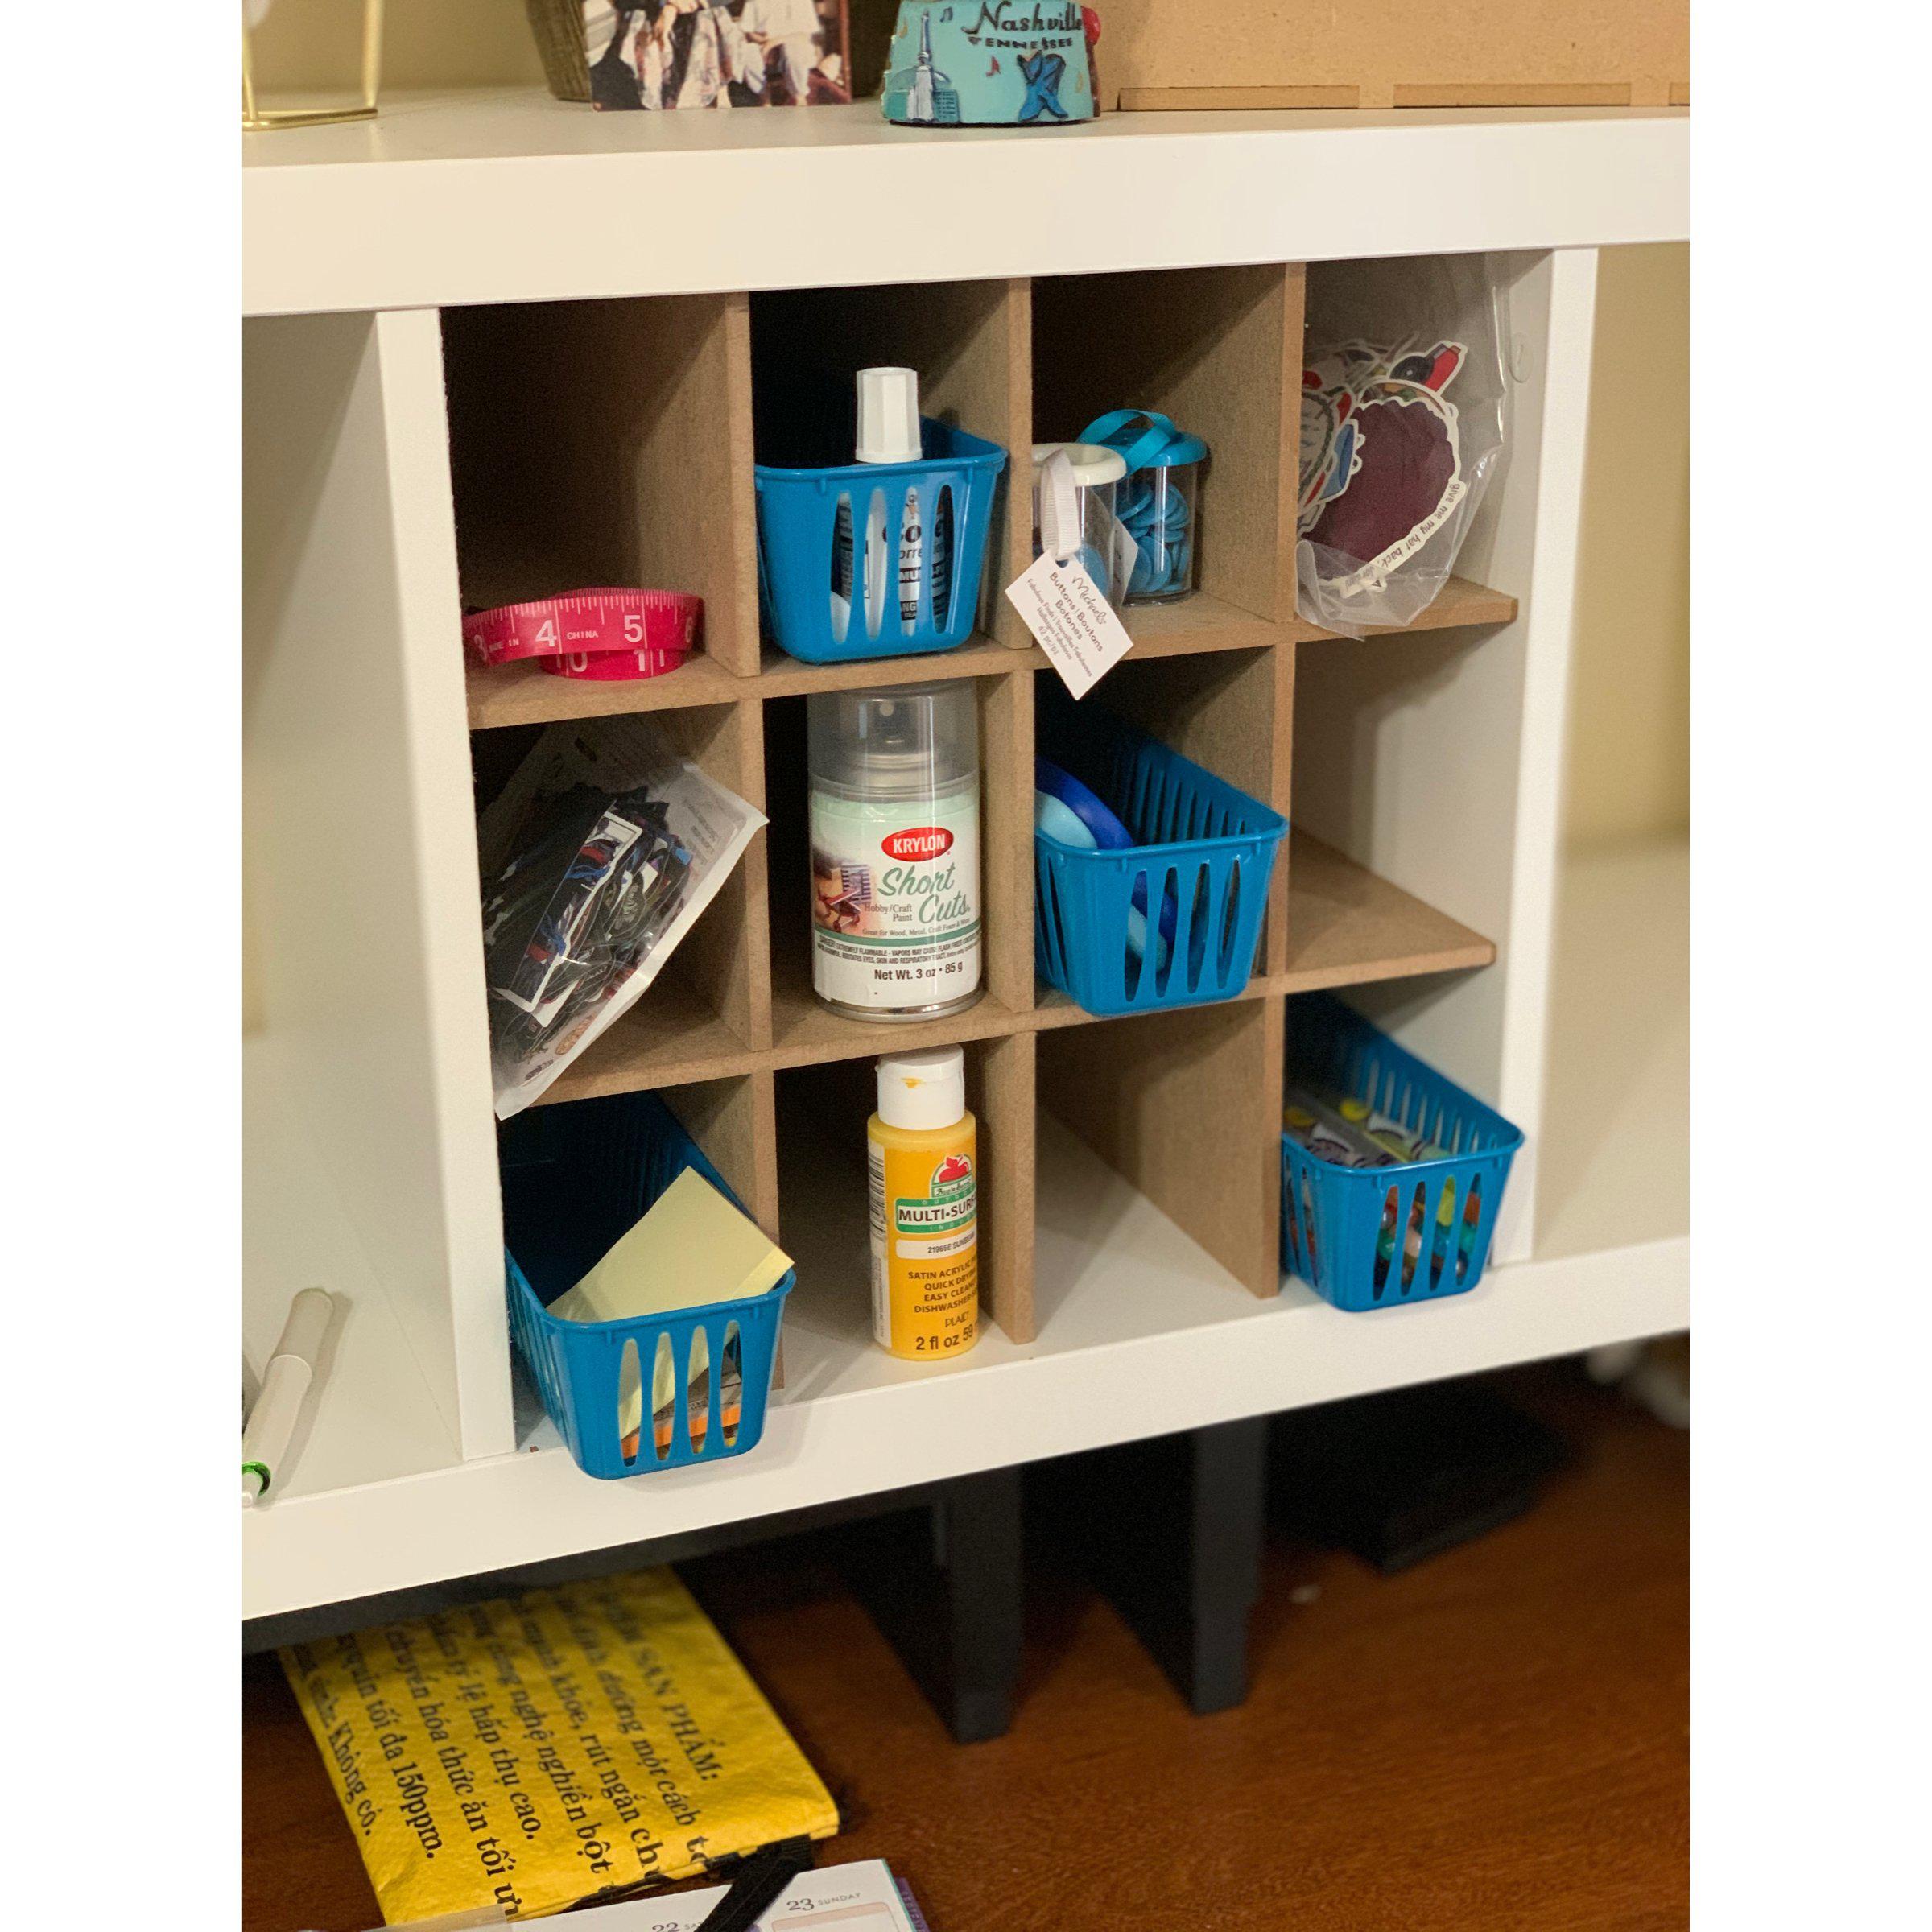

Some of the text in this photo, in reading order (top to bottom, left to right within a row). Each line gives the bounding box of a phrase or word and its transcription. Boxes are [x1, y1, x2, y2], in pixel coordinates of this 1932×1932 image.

[961, 1, 1083, 34] Nashville
[968, 36, 1073, 50] TENNESSEE
[1445, 483, 1461, 503] give
[1434, 506, 1447, 520] me
[1420, 521, 1435, 535] my
[1405, 534, 1421, 551] hat
[1050, 572, 1103, 652] Buttons Boutons
[1072, 576, 1106, 625] Michaels
[509, 638, 520, 647] IN
[535, 620, 558, 647] 4
[566, 630, 599, 641] CHINA
[624, 614, 643, 642] 5
[1055, 600, 1083, 640] Botones
[893, 834, 946, 854] KRYLON
[877, 862, 956, 896] Short
[864, 903, 913, 914] Hobby/Craft
[892, 914, 913, 922] Paint
[874, 961, 963, 980] Net Wt. 3 oz 85 g
[908, 1271, 937, 1279] SATIN
[939, 1259, 970, 1278] ACRYLIC
[924, 1280, 955, 1291] QUICK
[924, 1292, 948, 1302] EASY
[916, 1336, 925, 1350] 2
[929, 1335, 939, 1350] fl
[943, 1334, 960, 1348] oz
[963, 1323, 973, 1341] 59
[379, 1732, 408, 1761] đa
[489, 1748, 521, 1787] thụ
[510, 1792, 542, 1840] cao.
[356, 1799, 383, 1836] có.
[391, 1761, 443, 1859] 150ppm.
[438, 1746, 476, 1796] thức
[460, 1801, 489, 1833] ăn
[477, 1836, 517, 1877] tối
[576, 1821, 614, 1874] bột
[786, 1893, 861, 1911] 23 SUNDAY
